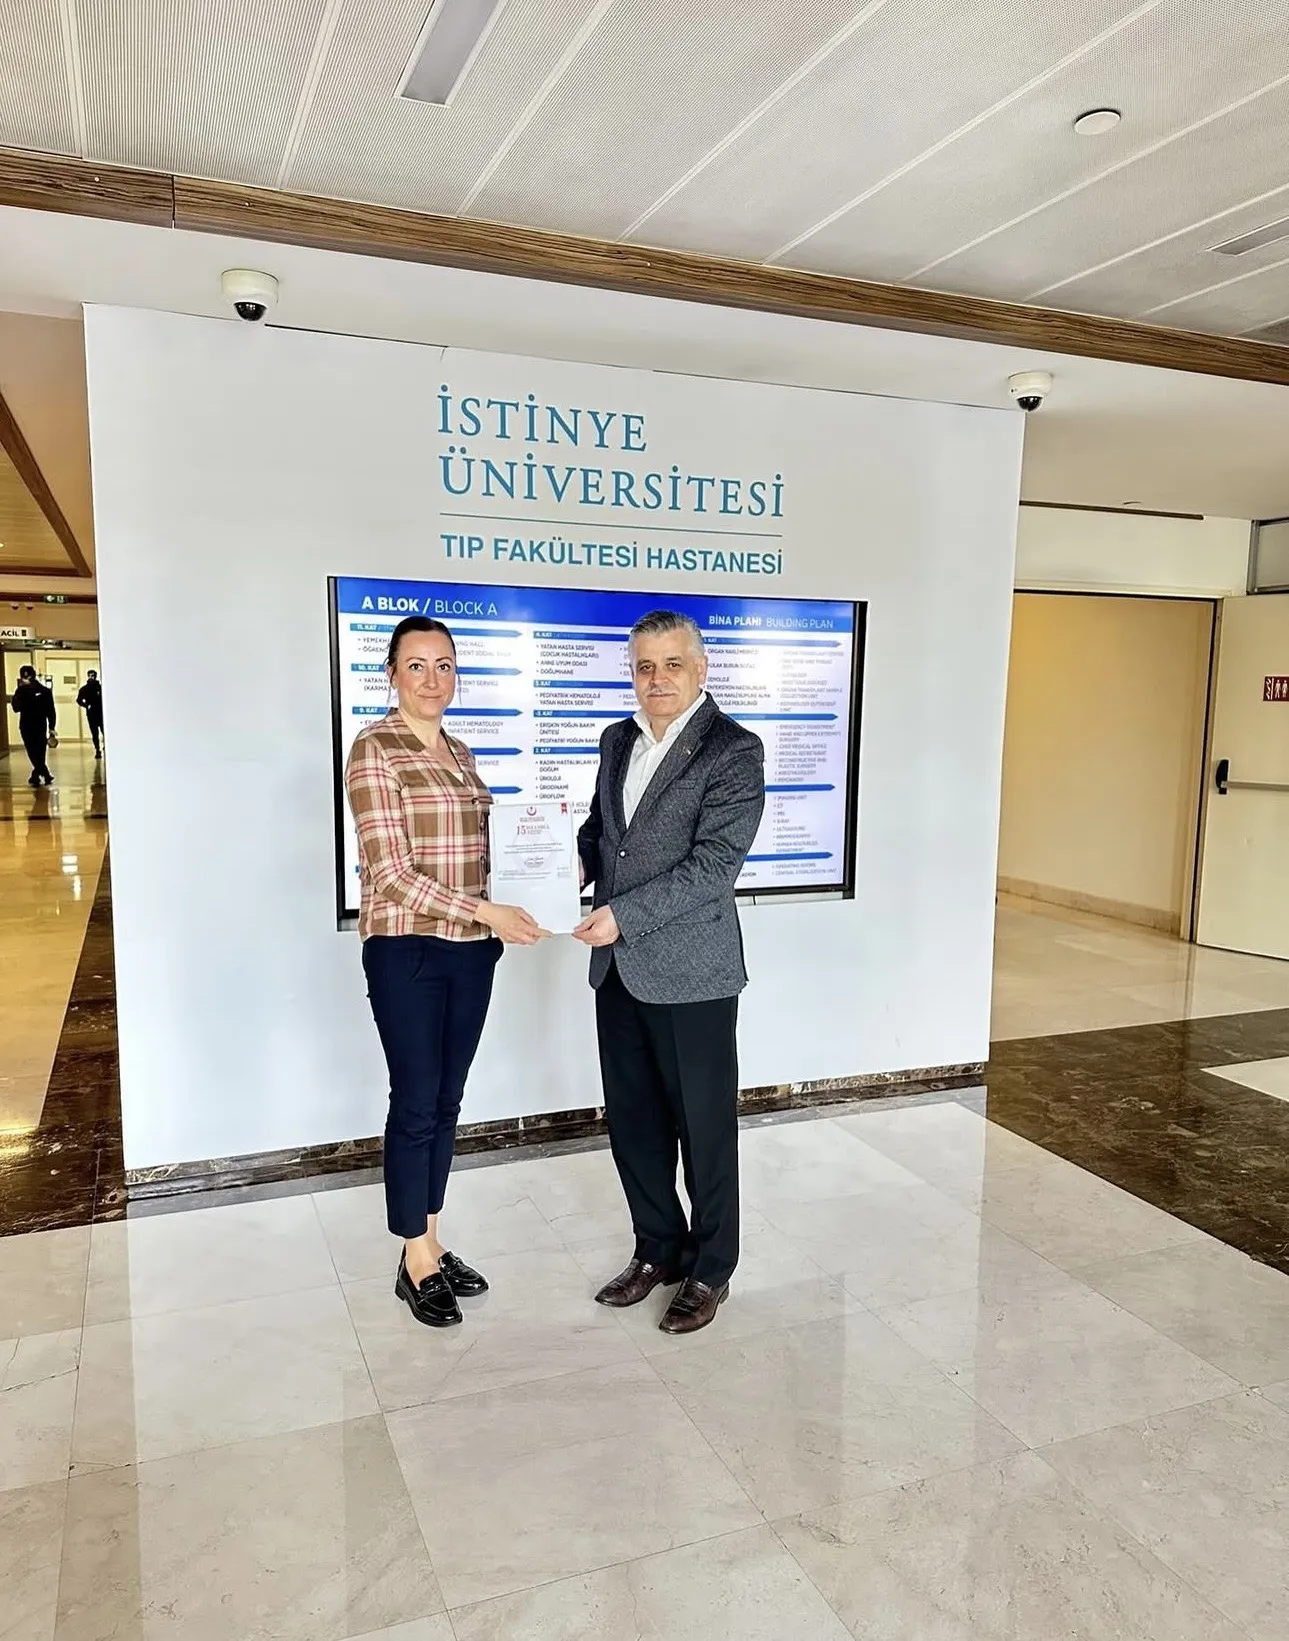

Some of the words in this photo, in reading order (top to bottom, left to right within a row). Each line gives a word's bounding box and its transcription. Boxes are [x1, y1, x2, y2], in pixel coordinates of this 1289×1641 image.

[437, 384, 647, 452] İSTİNYE
[439, 445, 784, 517] ÜNİVERSİTESİ
[440, 534, 484, 559] TIP
[493, 536, 638, 568] FAKÜLTESİ
[647, 548, 783, 575] HASTANESİ
[362, 596, 374, 610] A
[378, 597, 419, 612] BLOK
[422, 598, 431, 614] /
[435, 600, 484, 615] BLOCK
[487, 602, 498, 616] A
[709, 613, 731, 625] BİNA
[767, 618, 808, 629] BUILDING
[809, 620, 834, 629] PLAN
[1, 629, 19, 637] ACİL
